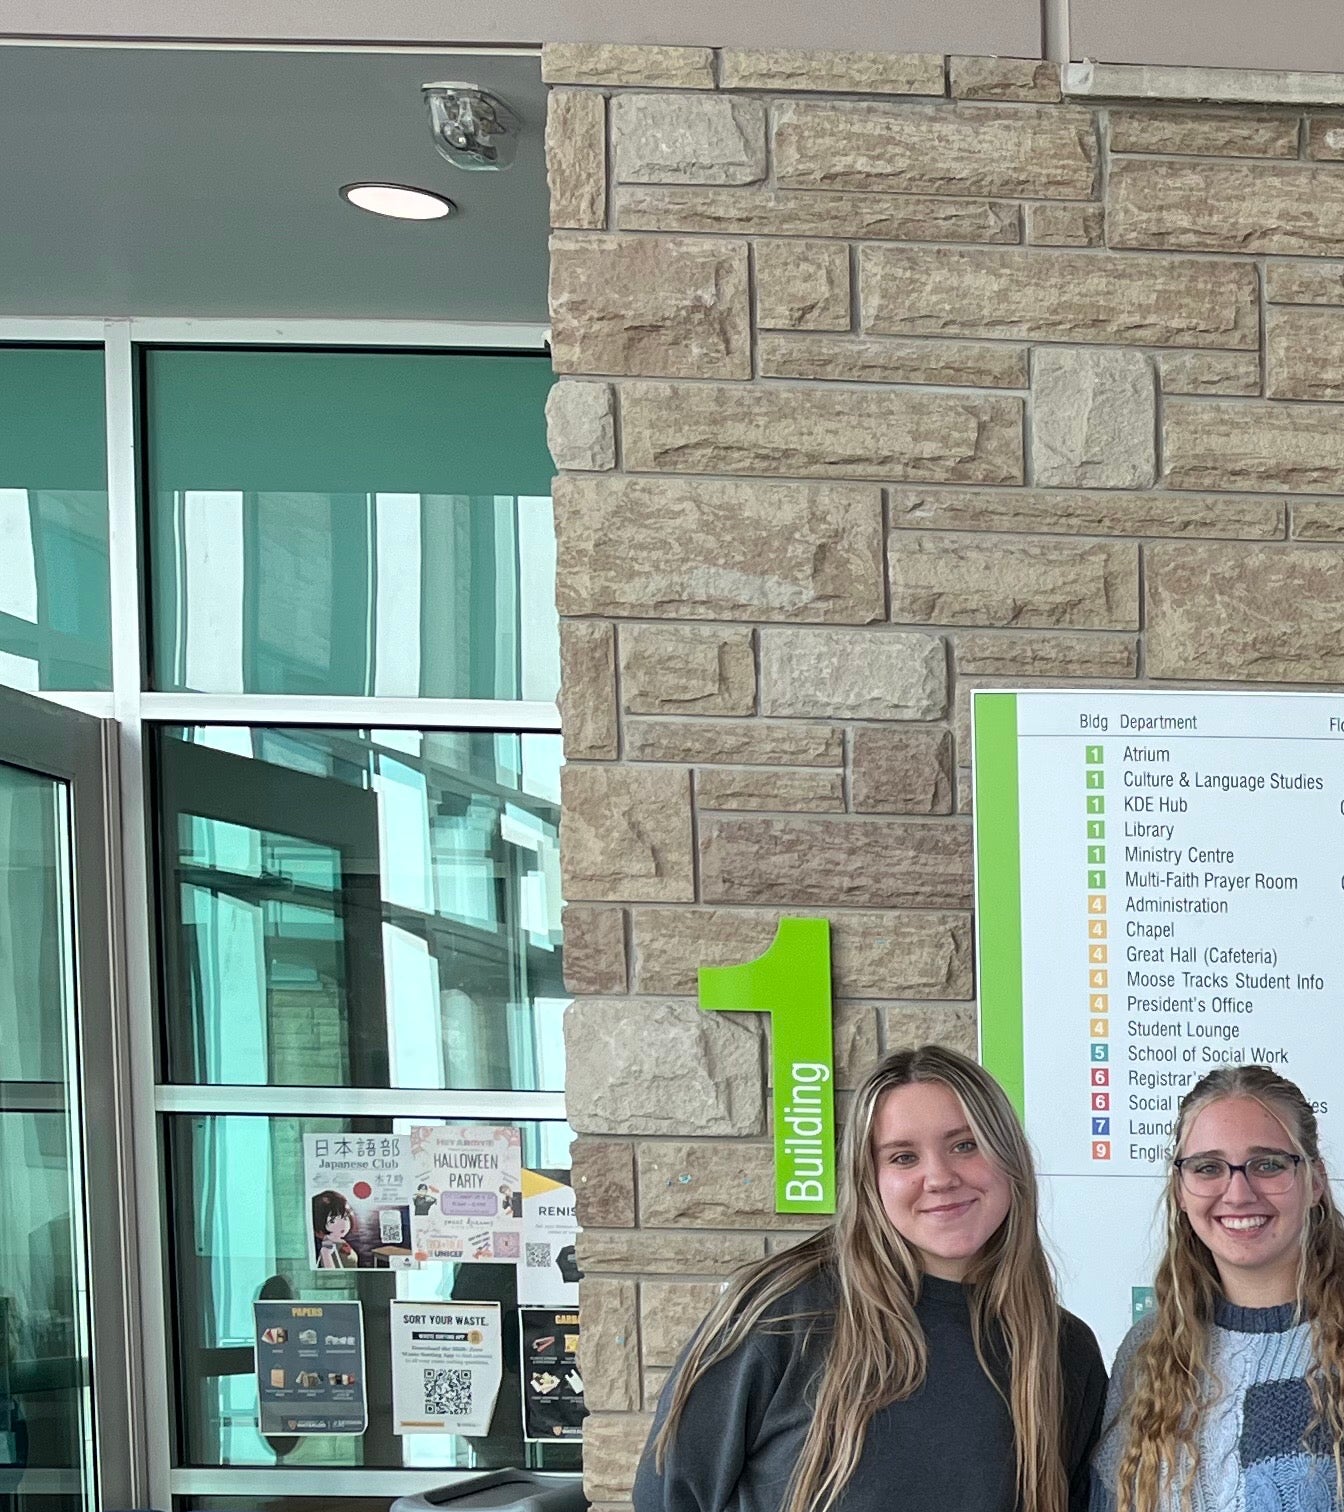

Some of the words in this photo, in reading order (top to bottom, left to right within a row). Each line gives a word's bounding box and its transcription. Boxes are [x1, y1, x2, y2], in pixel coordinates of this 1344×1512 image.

[1080, 714, 1107, 731] Bldg
[1121, 714, 1197, 731] Department
[1123, 746, 1169, 761] Atrium
[1124, 771, 1173, 787] Culture
[1179, 772, 1190, 787] &
[1196, 772, 1264, 792] Language
[1271, 773, 1323, 789] Studies
[1125, 796, 1153, 812] KDE
[1160, 797, 1187, 812] Hub
[1125, 822, 1174, 840] Library
[1126, 846, 1182, 865] Ministry
[1189, 847, 1234, 863] Centre
[1126, 871, 1198, 887] Multi-Faith
[1205, 873, 1250, 891] Prayer
[1256, 873, 1297, 889] Room
[1126, 897, 1227, 913] Administration
[1127, 921, 1174, 940] Chapel
[1127, 946, 1164, 962] Great
[1171, 947, 1196, 962] Hall
[1204, 947, 1277, 968] (Cafeteria)
[1128, 971, 1175, 987] Moose
[1182, 972, 1228, 988] Tracks
[1236, 972, 1290, 989] Student
[1298, 974, 1323, 990] Info
[1128, 996, 1205, 1012] President's
[1212, 997, 1253, 1013] Office
[1128, 1021, 1181, 1037] Student
[1187, 1022, 1239, 1041] Lounge
[1129, 1045, 1176, 1061] School
[1183, 1047, 1196, 1062] of
[1202, 1046, 1245, 1062] Social
[1251, 1048, 1288, 1063] Work
[784, 1062, 830, 1201] Building
[315, 1137, 400, 1158] 日本語部
[1130, 1144, 1176, 1162] Englis
[319, 1159, 369, 1169] Japanese
[372, 1159, 399, 1169] Club
[434, 1153, 498, 1169] HALLOWEEN
[450, 1174, 484, 1188] PARTY
[538, 1206, 578, 1216] RENIS
[403, 1315, 427, 1325] SORT
[430, 1315, 453, 1325] YOUR
